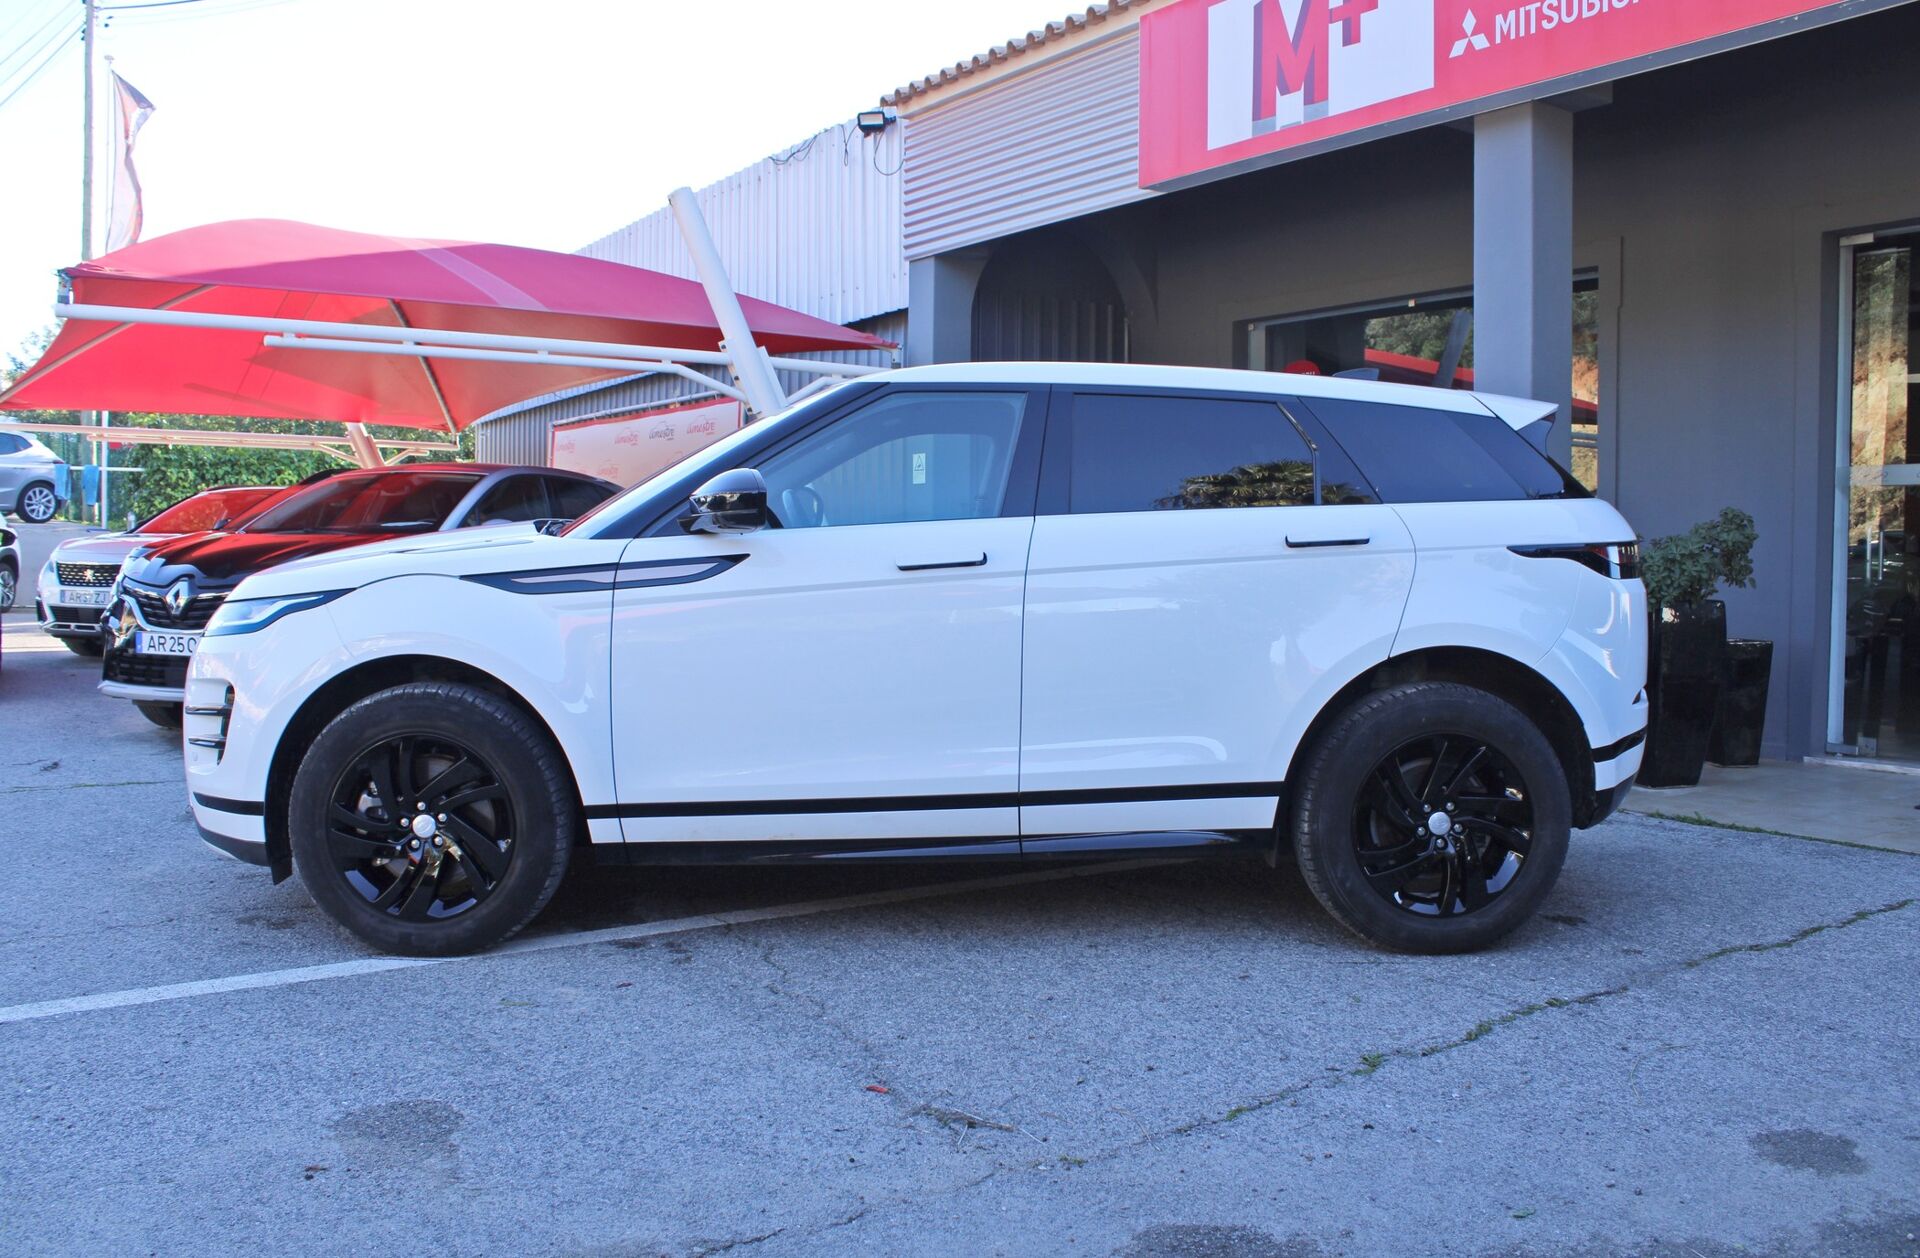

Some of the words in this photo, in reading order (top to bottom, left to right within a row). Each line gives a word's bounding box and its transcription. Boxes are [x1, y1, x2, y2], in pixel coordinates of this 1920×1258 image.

[1495, 0, 1639, 44] MITSUB
[147, 635, 167, 652] AR
[169, 636, 185, 653] 25
